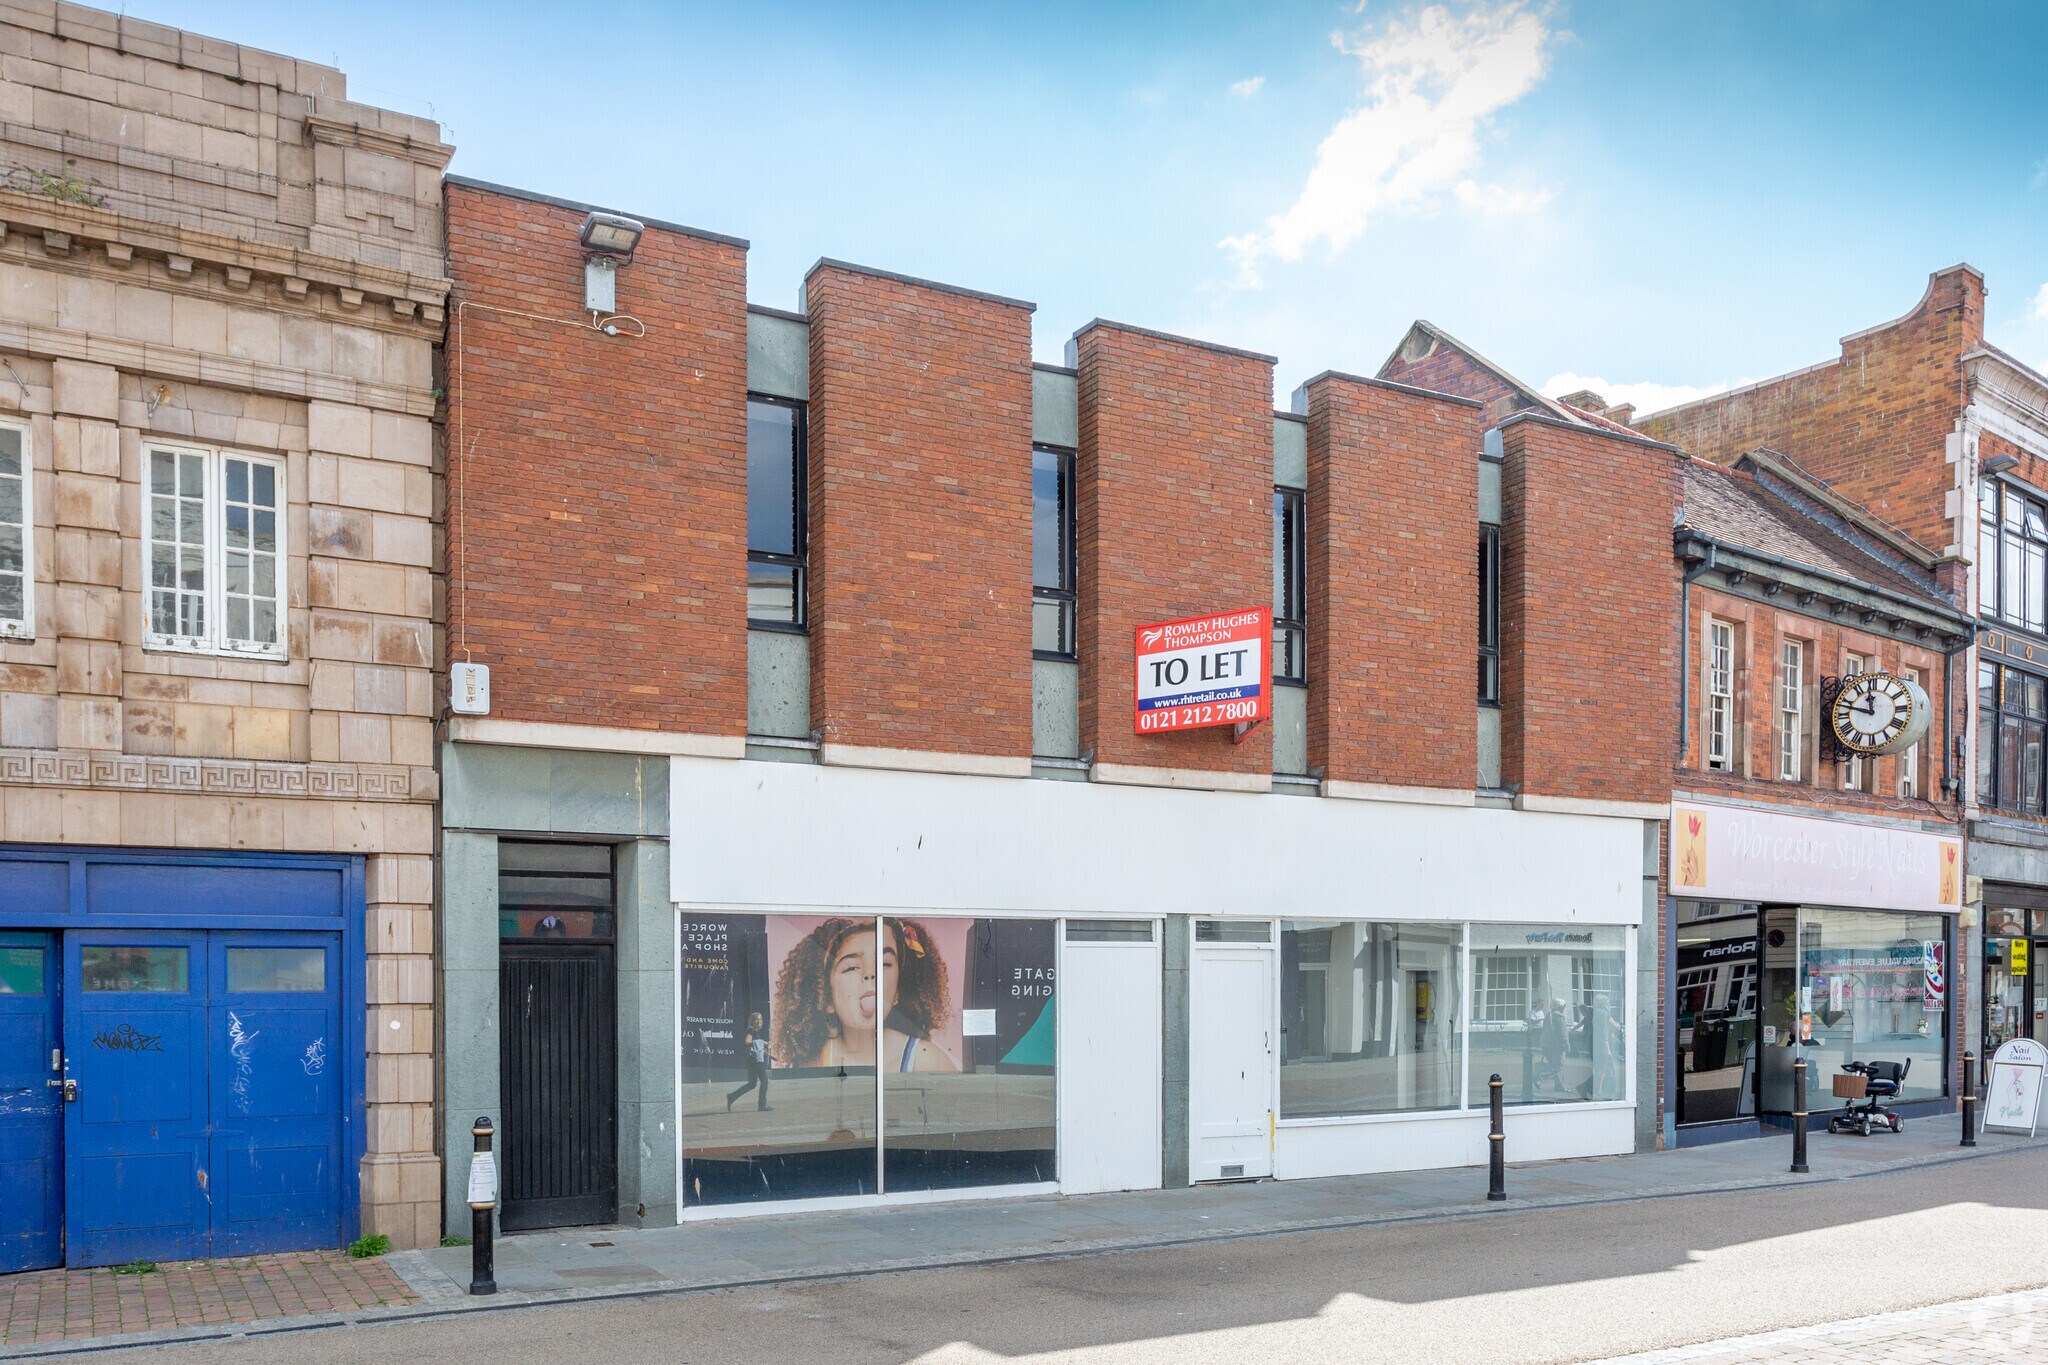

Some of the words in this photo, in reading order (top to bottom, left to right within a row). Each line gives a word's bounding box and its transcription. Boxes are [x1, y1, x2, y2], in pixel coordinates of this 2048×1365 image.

[1164, 621, 1210, 637] ROWLEY
[1212, 613, 1259, 629] HUGHES
[1164, 630, 1232, 648] THOMPSON
[1150, 658, 1189, 687] TO
[1200, 649, 1248, 681] LET
[1154, 688, 1242, 708] www.rhtretail.co.uk
[1141, 711, 1177, 730] 0121
[1183, 707, 1212, 725] 212
[1217, 700, 1257, 720] 7800
[1728, 819, 1828, 865] Worcester
[1832, 833, 1874, 880] Style
[1877, 835, 1927, 880] Nails
[2009, 1055, 2034, 1063] Salon
[2012, 1045, 2033, 1056] Nail
